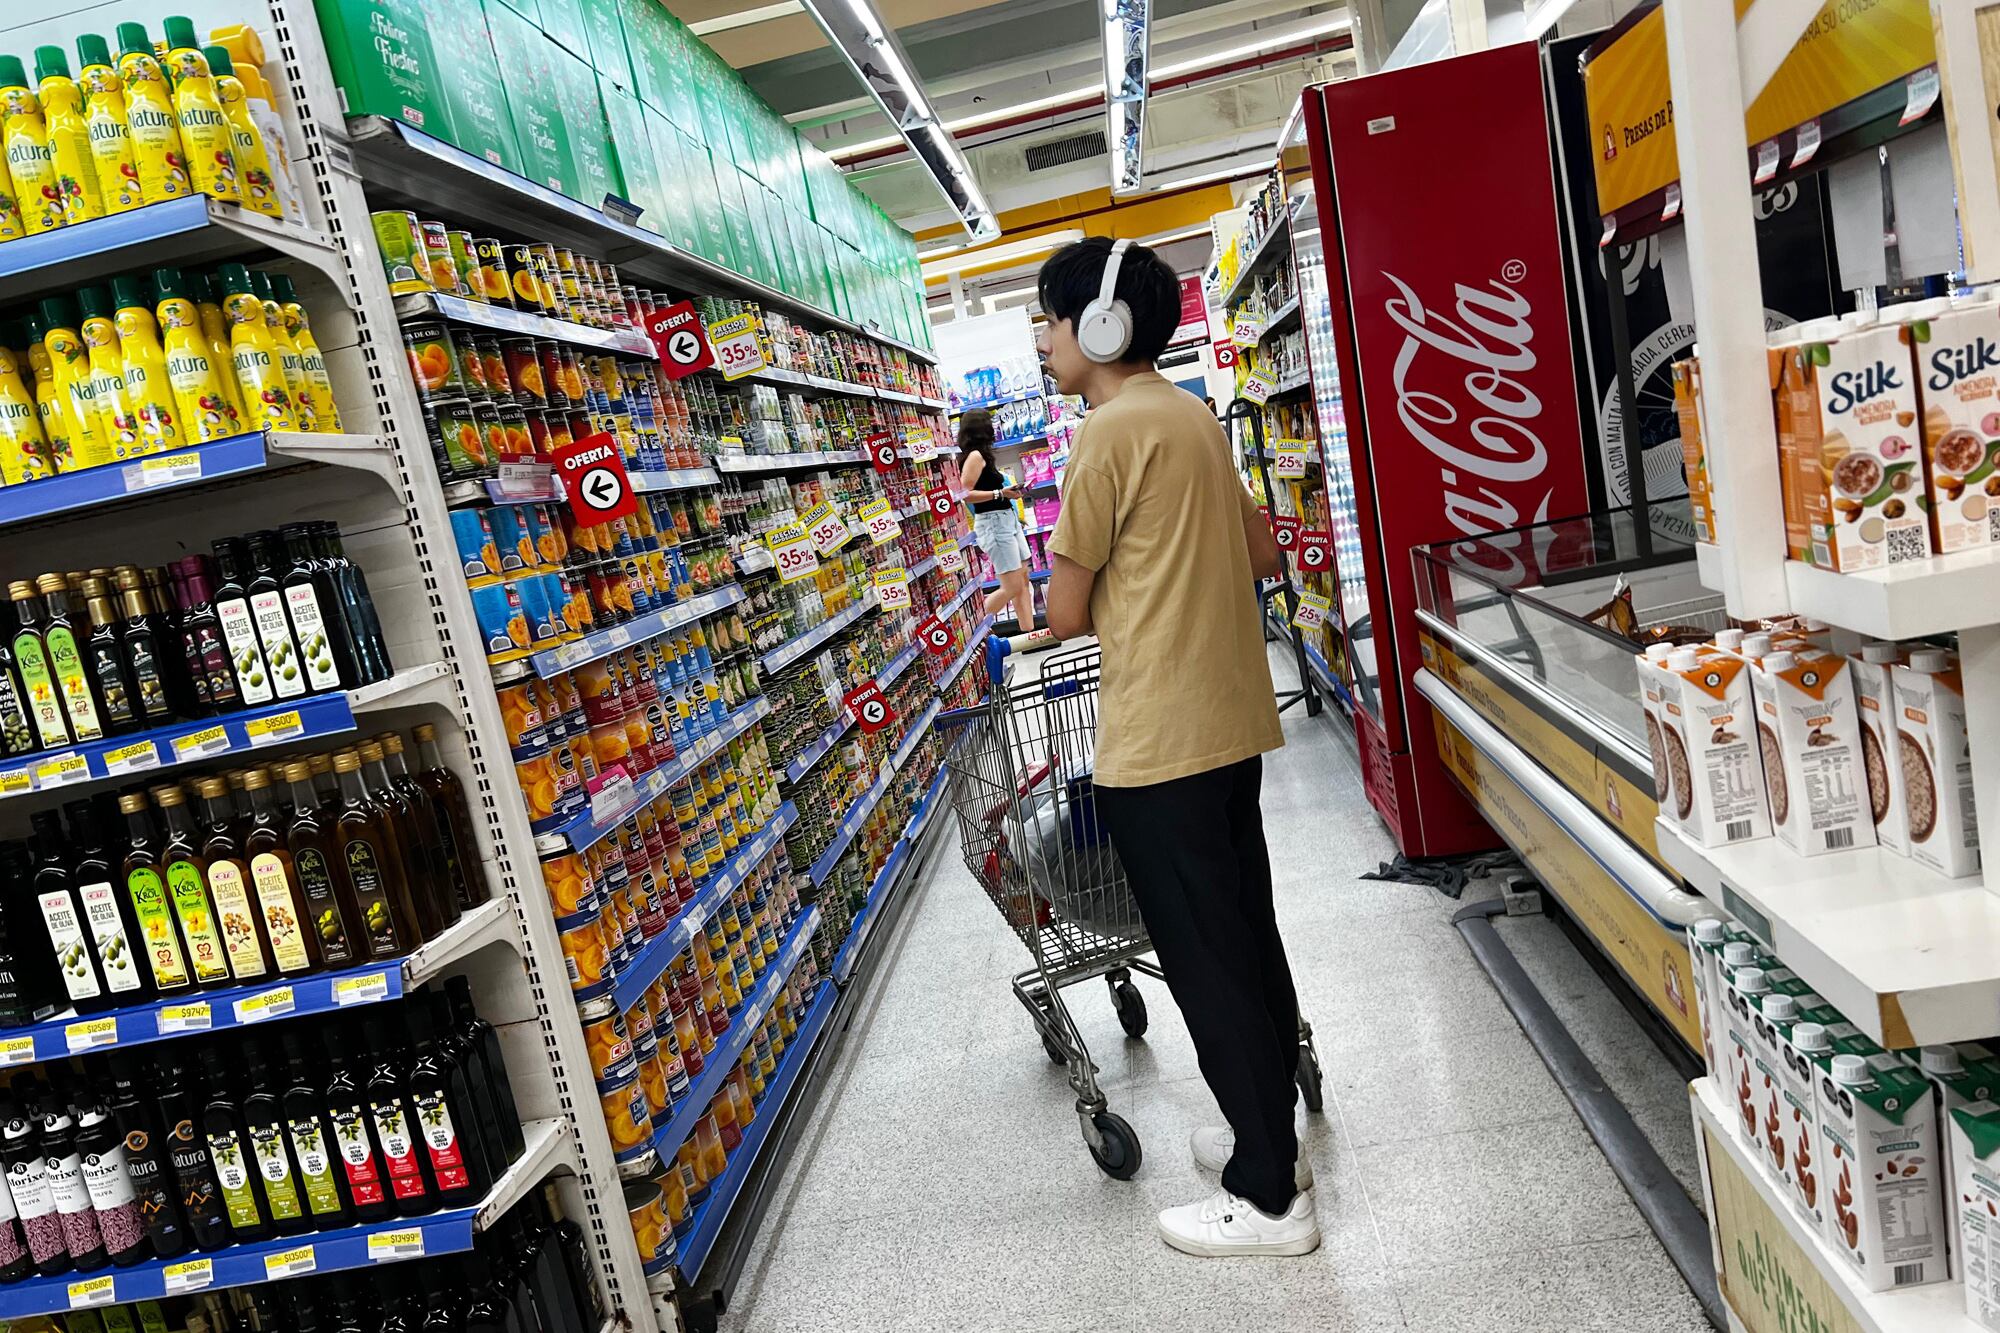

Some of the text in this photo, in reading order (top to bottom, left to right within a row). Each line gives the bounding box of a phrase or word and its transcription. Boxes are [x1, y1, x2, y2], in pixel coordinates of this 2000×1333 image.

[1823, 11, 1837, 34] SU
[1624, 108, 1667, 148] PRESAS DE
[654, 311, 694, 334] OFERTA
[722, 343, 758, 364] 35%
[1929, 336, 2000, 391] Silk
[1828, 360, 1903, 415] Silk
[871, 437, 892, 447] OFERTA
[564, 445, 614, 470] OFERTA
[1278, 455, 1303, 469] 25%
[1607, 447, 1626, 470] CON
[930, 490, 949, 499] OFERTA
[870, 518, 896, 535] 35%
[1276, 520, 1298, 528] OFERTA
[813, 523, 842, 545] 35%
[1302, 536, 1328, 544] OFERTA
[779, 548, 814, 569] 35%
[881, 586, 907, 601] 35%
[293, 603, 316, 615] ACEITE
[1298, 606, 1321, 622] 25%
[259, 611, 282, 623] ACEITE
[304, 612, 318, 622] OLIVA
[226, 618, 248, 630] ACEITE
[270, 620, 284, 630] OLIVA
[921, 620, 941, 636] OFERTA
[236, 627, 250, 637] OLIVA
[851, 686, 878, 706] OFERTA
[264, 714, 292, 729] $8500
[193, 728, 220, 744] $5800
[121, 743, 147, 759] $6800
[259, 875, 282, 886] ACEITE
[173, 878, 200, 898] KROL
[216, 882, 239, 894] ACEITE
[134, 885, 160, 905] KROL
[90, 903, 113, 914] ACEITE
[49, 910, 72, 922] ACEITE
[355, 976, 380, 989] $10647
[263, 992, 289, 1006] $8250
[181, 1007, 206, 1018] $9747
[87, 1021, 111, 1034] $12589
[6, 1042, 29, 1052] $15100
[390, 1233, 415, 1244] $13499
[284, 1250, 308, 1263] $13500
[182, 1261, 206, 1274] $14536
[84, 1281, 107, 1292] $10680
